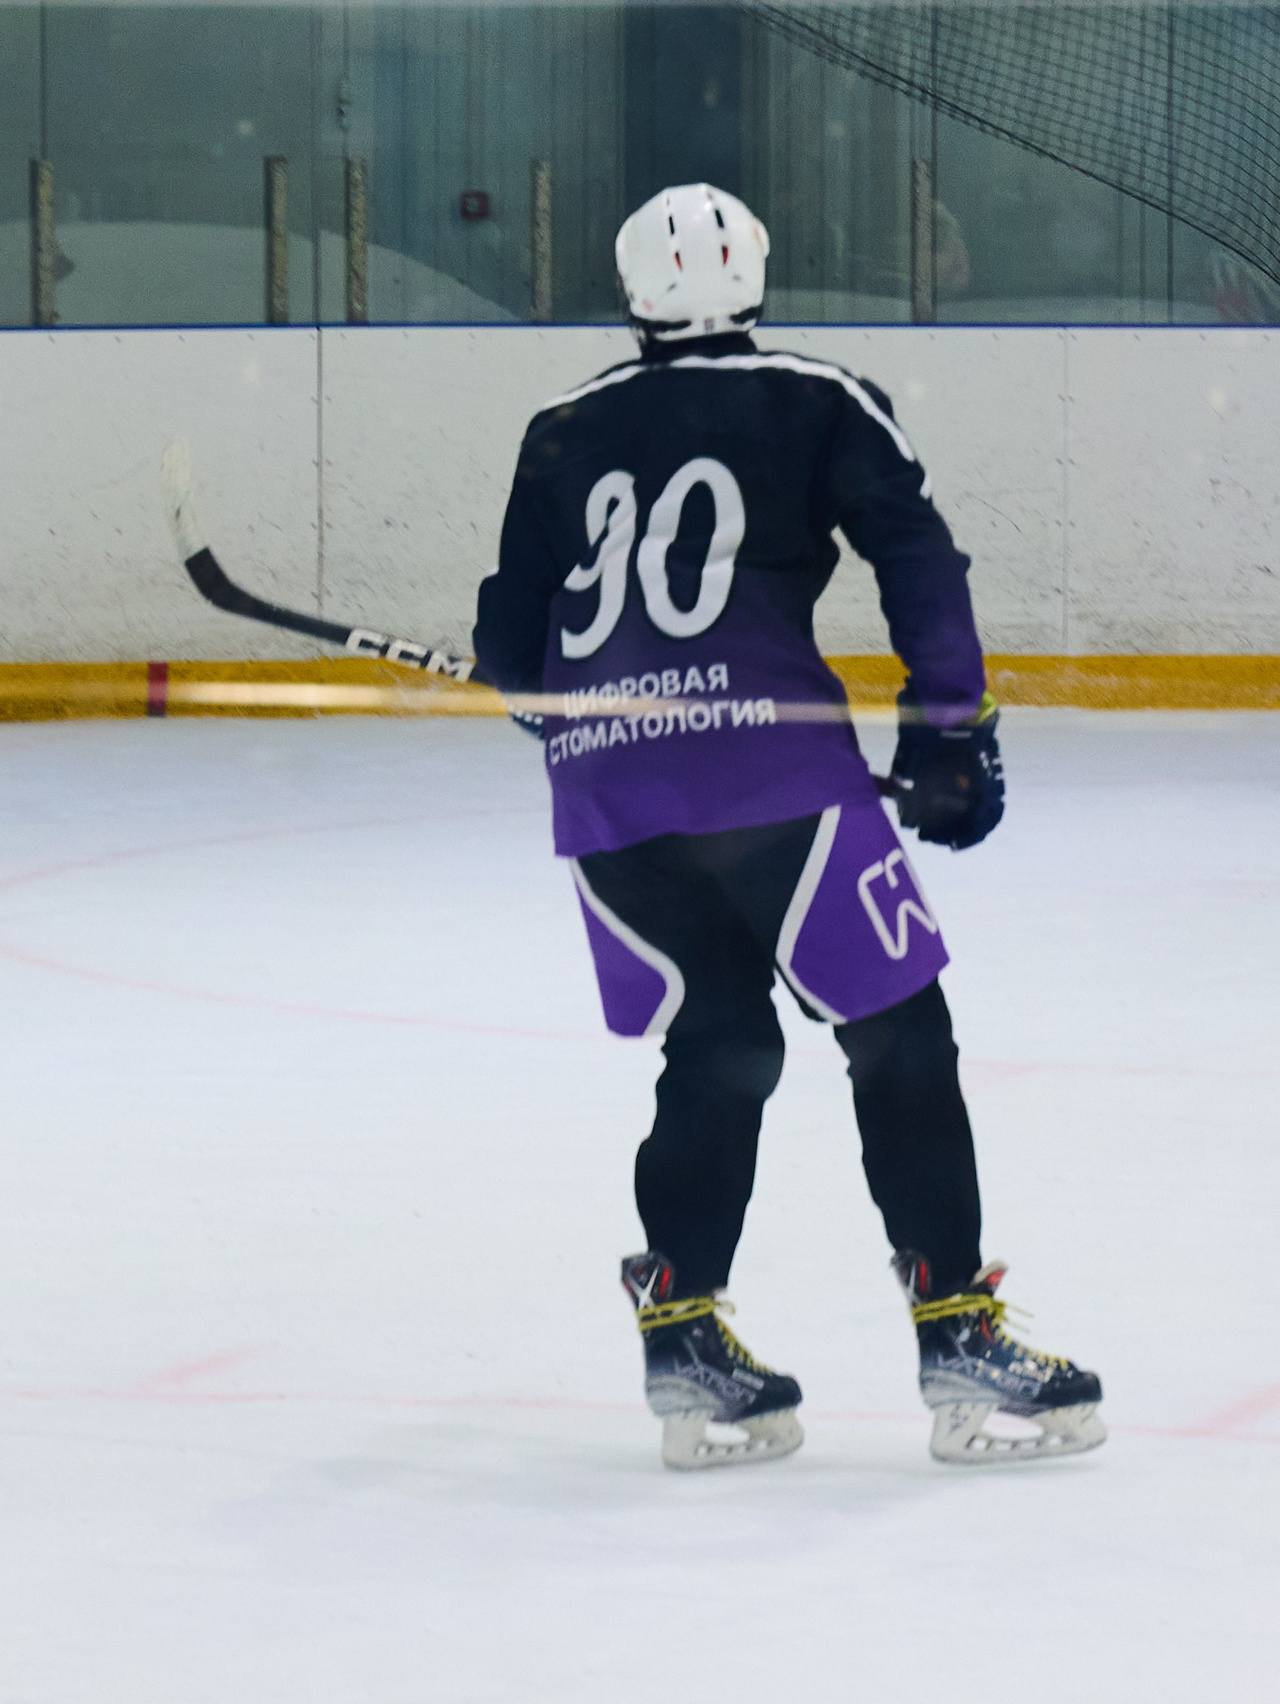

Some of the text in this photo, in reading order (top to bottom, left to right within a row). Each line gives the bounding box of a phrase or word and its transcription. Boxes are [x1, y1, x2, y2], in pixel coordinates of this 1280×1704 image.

[561, 457, 746, 660] 90
[345, 627, 476, 683] CCM
[563, 662, 730, 721] ЦИФРОВАЯ
[549, 697, 778, 767] СТОМАТОЛОГИЯ
